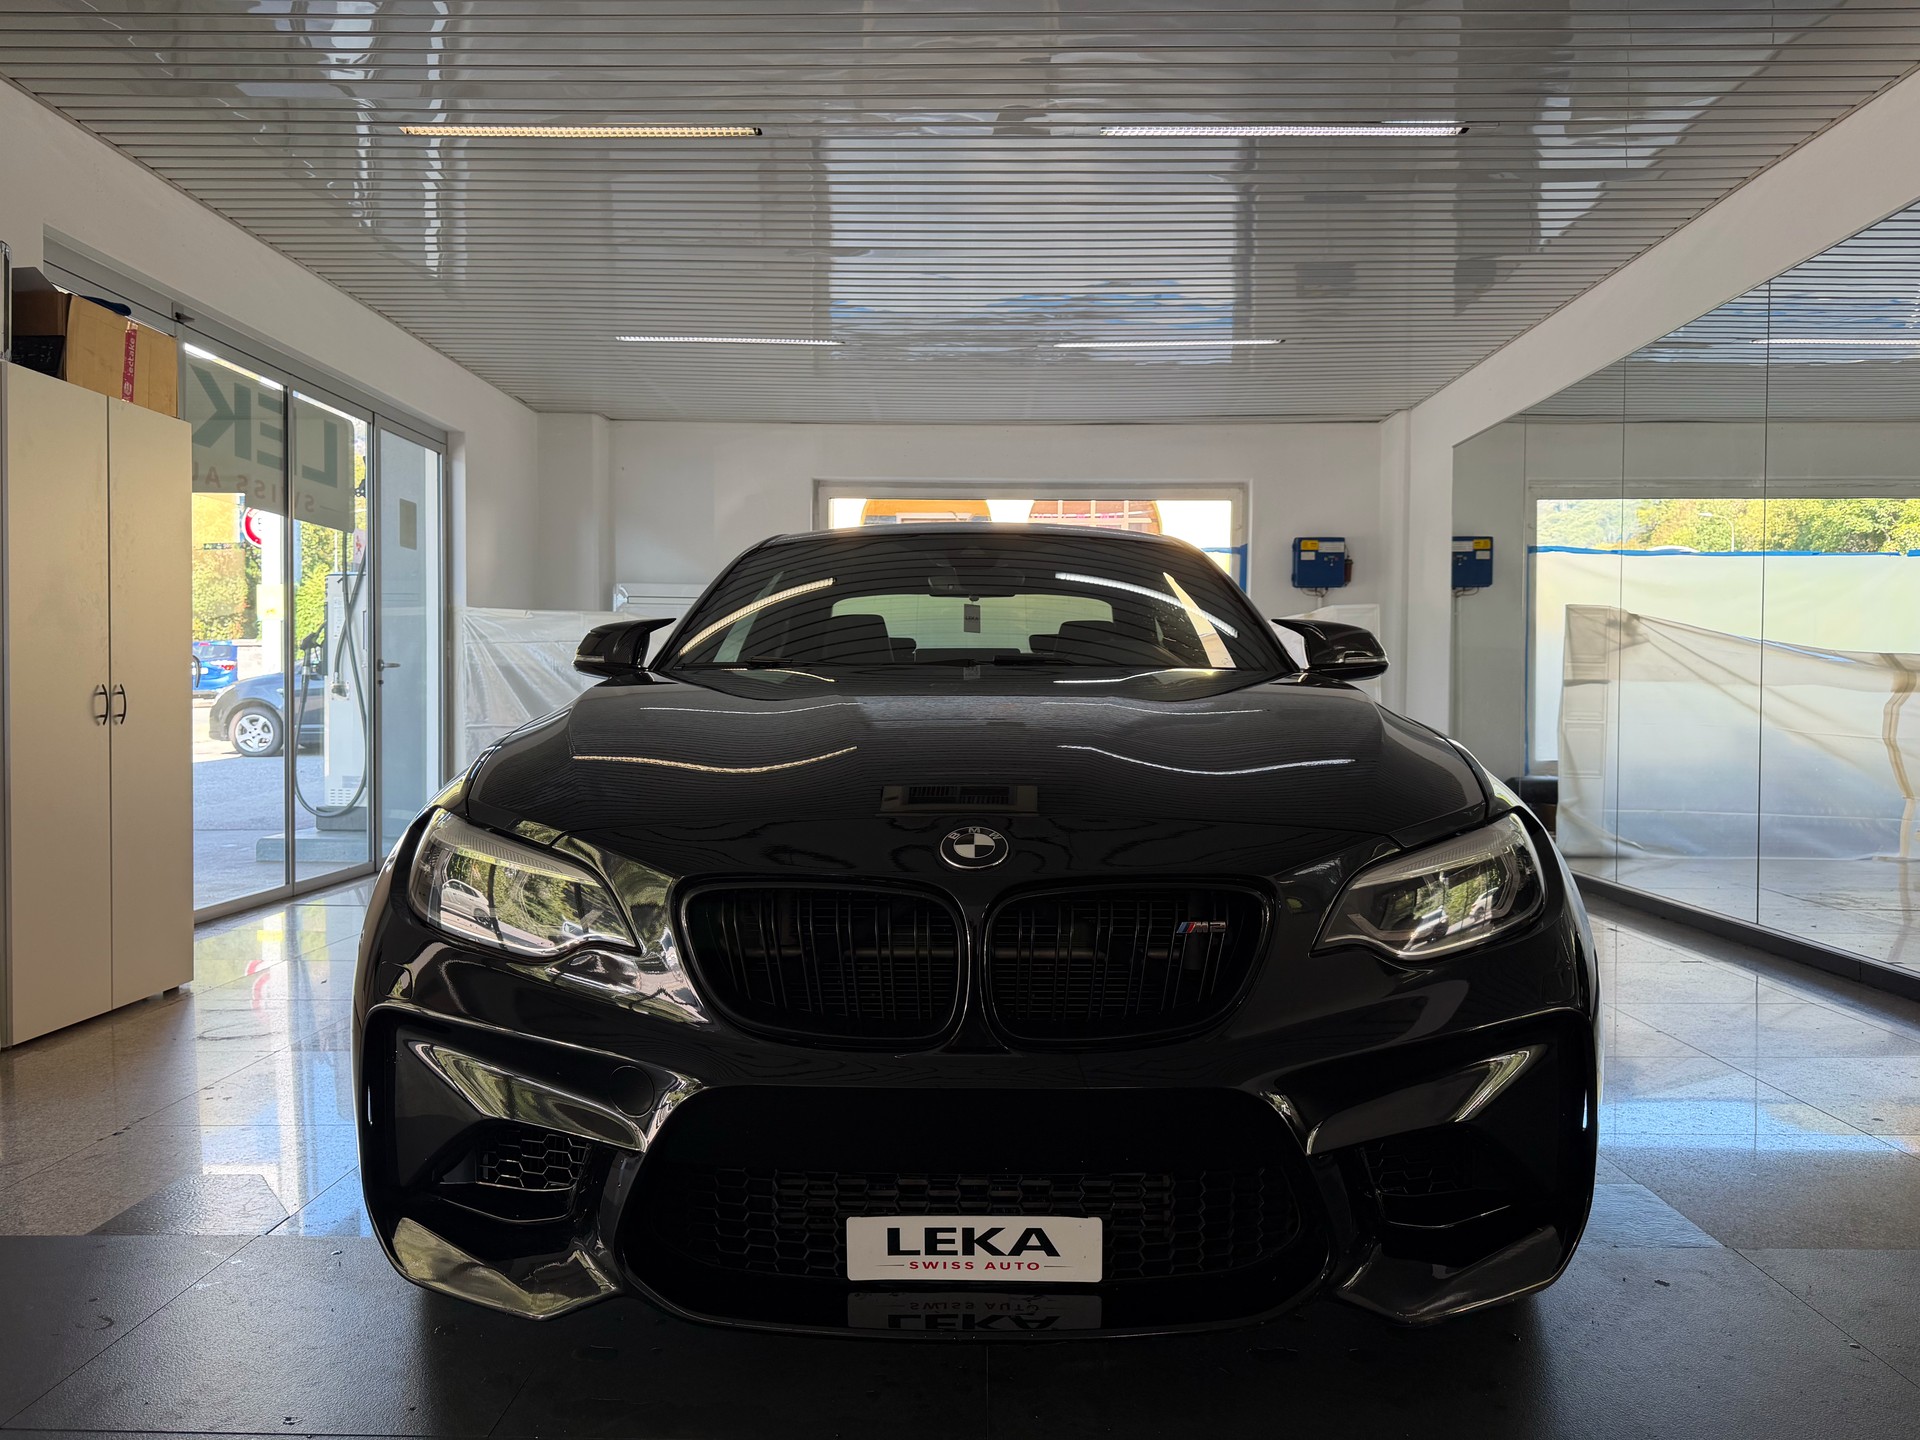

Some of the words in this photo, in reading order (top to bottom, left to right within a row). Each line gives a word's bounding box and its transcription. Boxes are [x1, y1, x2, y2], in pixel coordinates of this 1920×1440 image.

[948, 827, 1002, 840] BMW
[887, 1227, 1061, 1257] LEKA
[909, 1261, 975, 1270] SWISS
[984, 1261, 1041, 1271] AUTO
